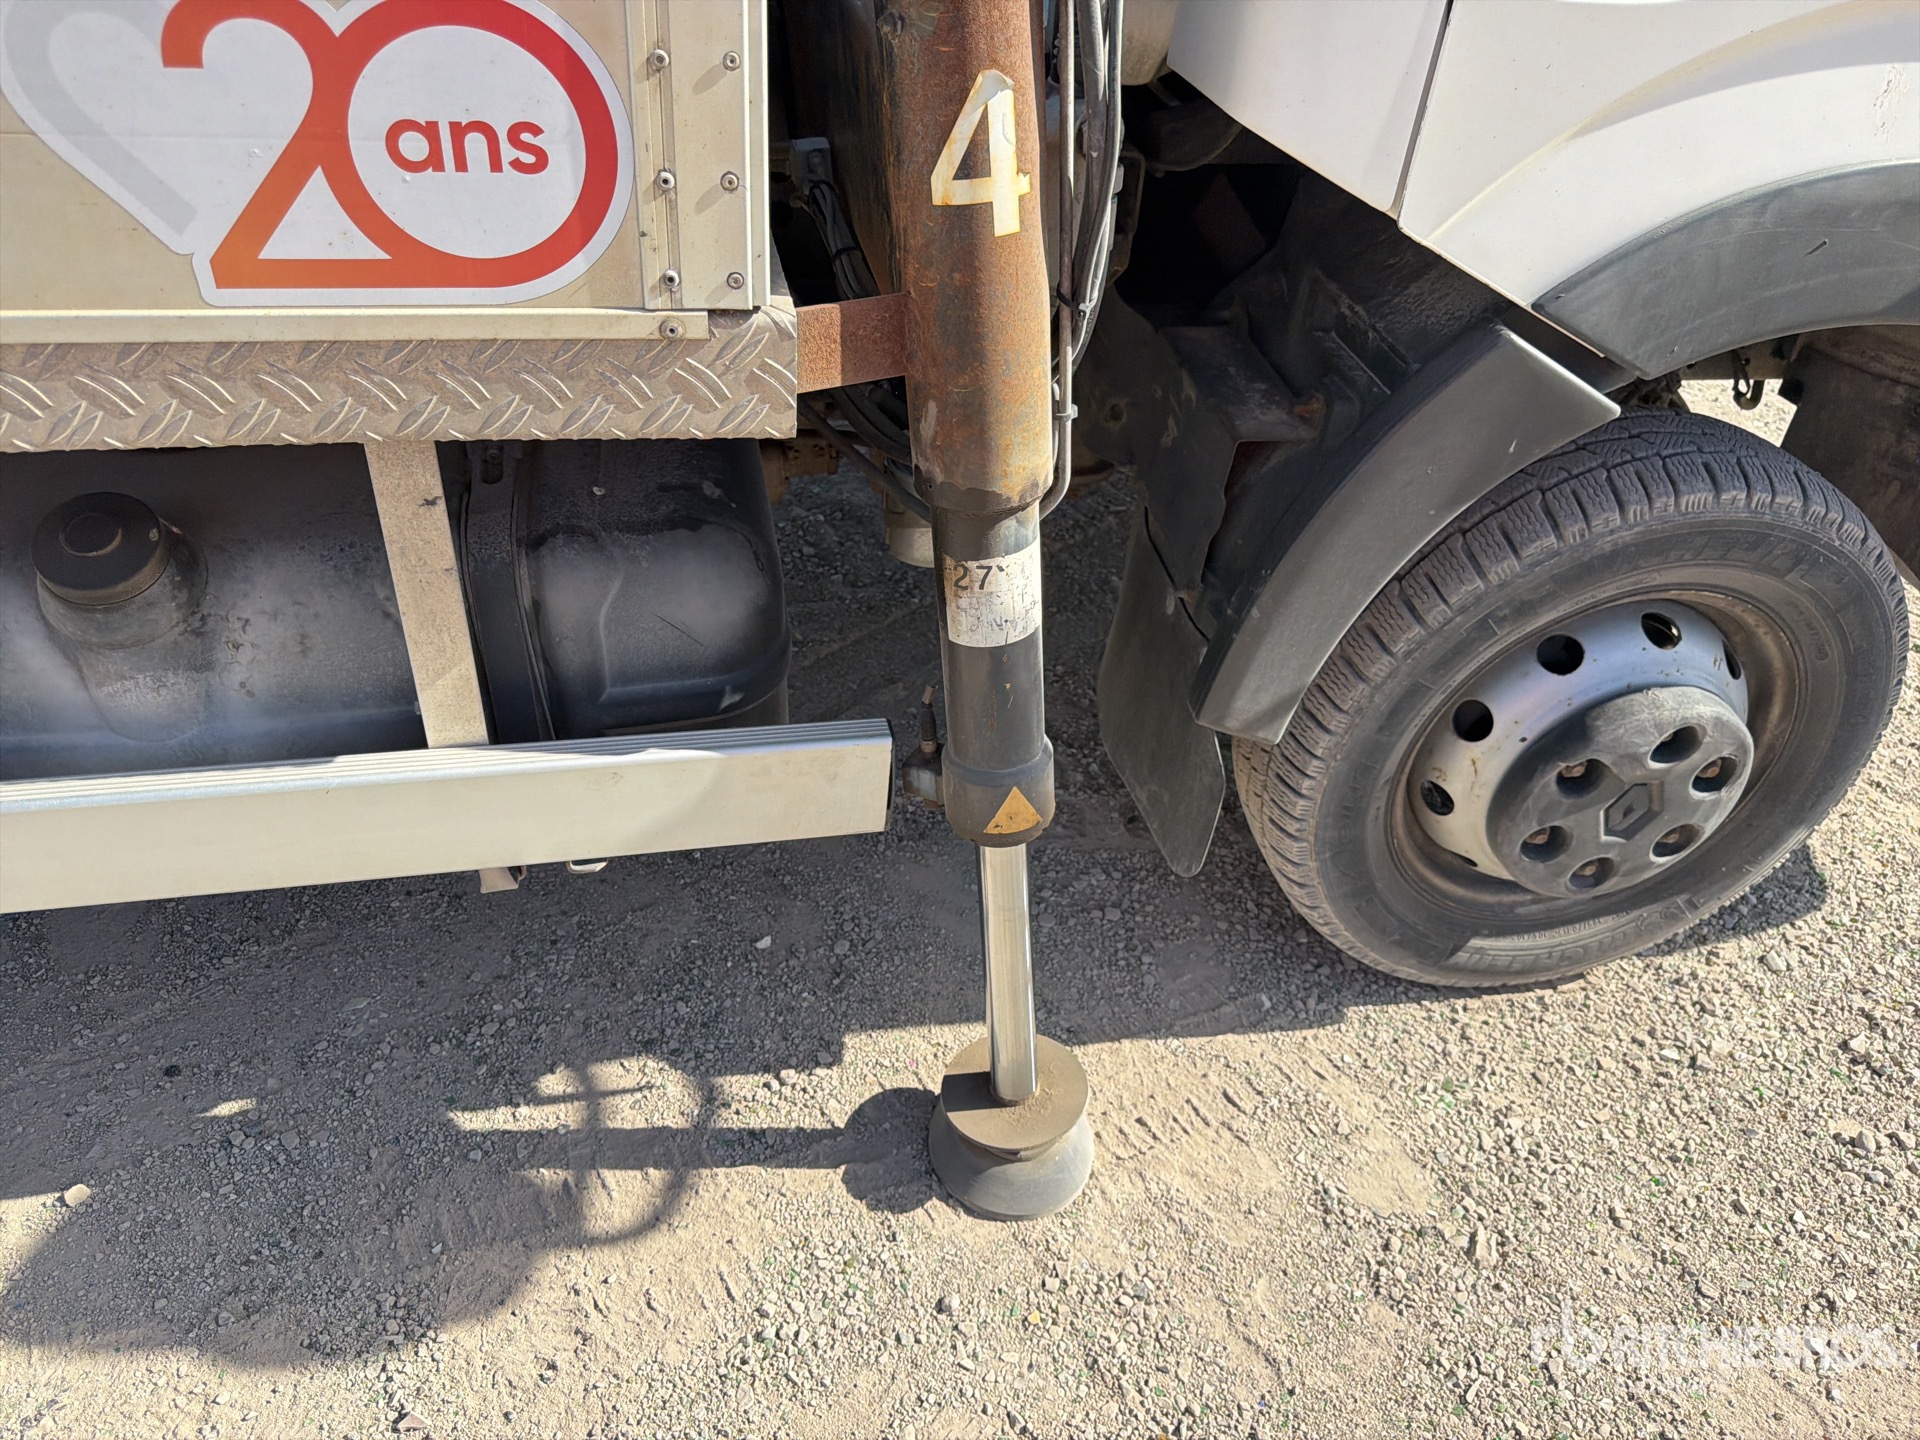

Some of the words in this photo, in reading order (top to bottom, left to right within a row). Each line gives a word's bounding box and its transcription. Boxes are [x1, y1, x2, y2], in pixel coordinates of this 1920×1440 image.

[161, 0, 619, 289] 20
[385, 117, 549, 174] ans
[930, 69, 1031, 237] 4
